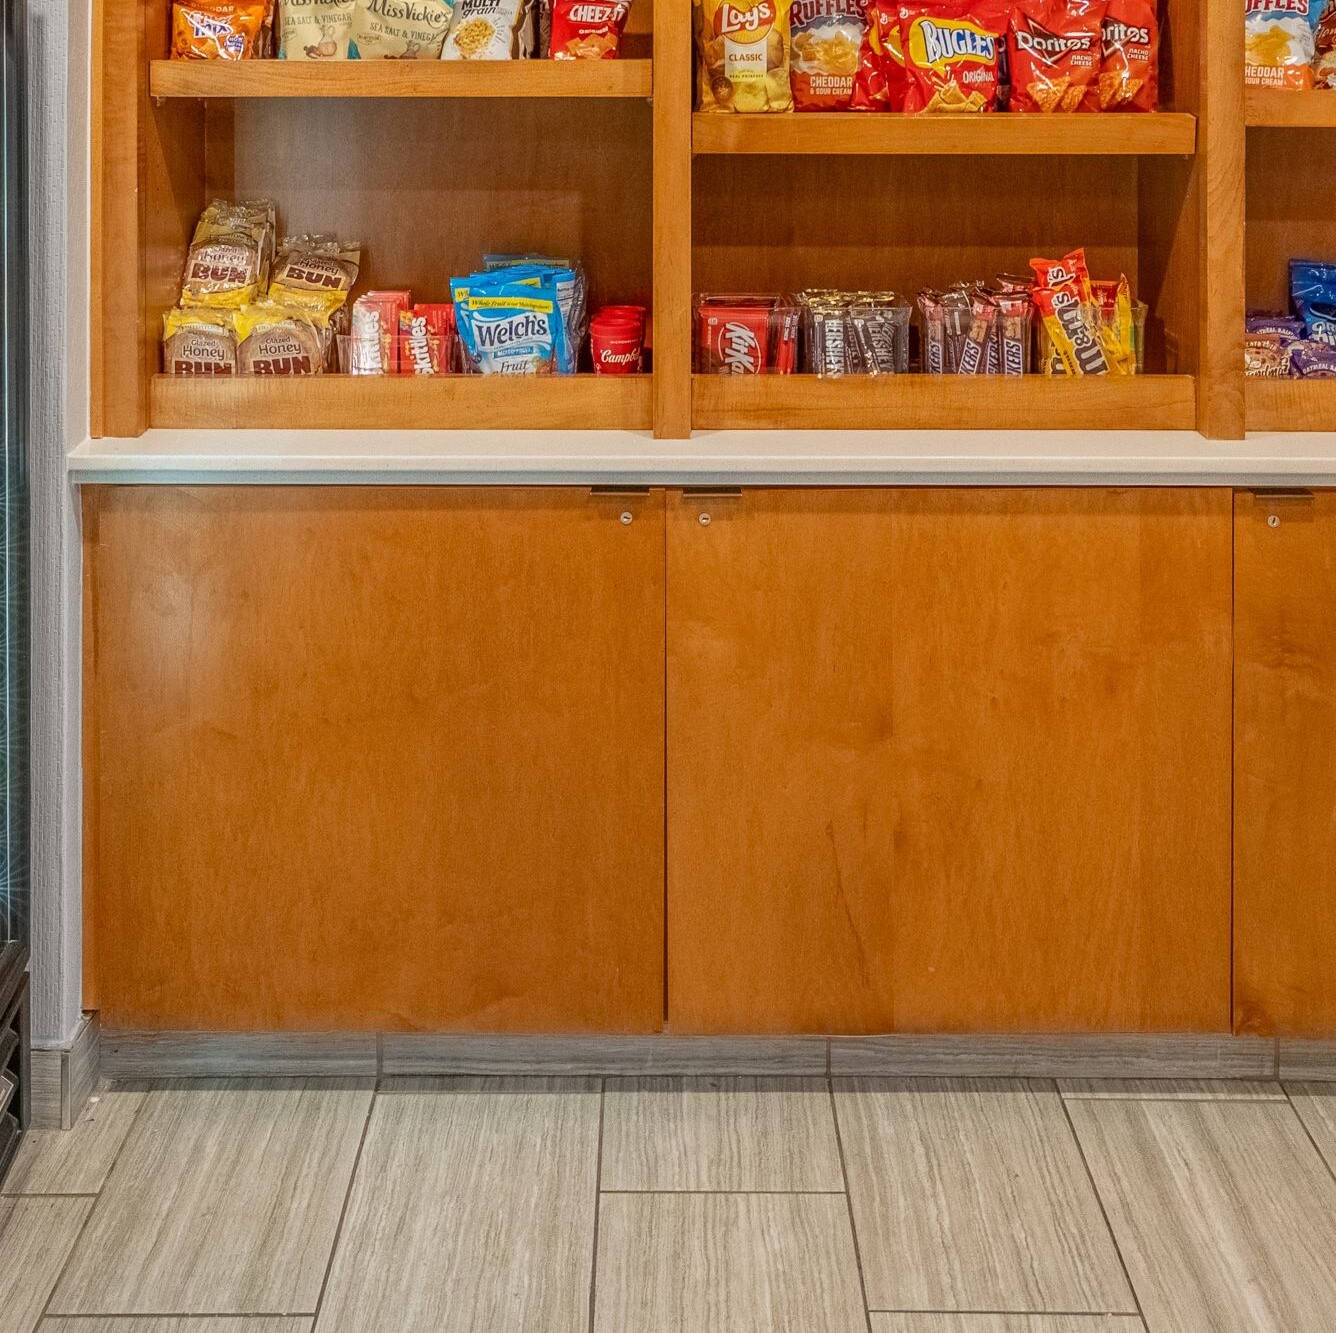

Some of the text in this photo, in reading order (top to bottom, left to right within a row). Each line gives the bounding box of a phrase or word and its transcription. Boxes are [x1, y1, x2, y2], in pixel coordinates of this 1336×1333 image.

[461, 0, 501, 10] MULTI
[404, 1, 450, 28] Vickie's
[462, 7, 496, 19] grain
[918, 20, 995, 63] BUGLES
[1018, 31, 1091, 52] Doritos
[728, 54, 763, 62] CLASSIC
[810, 76, 853, 87] CHEDDAR
[286, 267, 342, 288] BUN
[474, 315, 548, 347] Welch's
[191, 339, 216, 347] Glazed
[259, 343, 302, 355] Honey
[183, 346, 225, 360] Honey
[174, 360, 232, 374] BUN
[253, 356, 311, 374] BUN
[500, 360, 528, 373] Fruit
